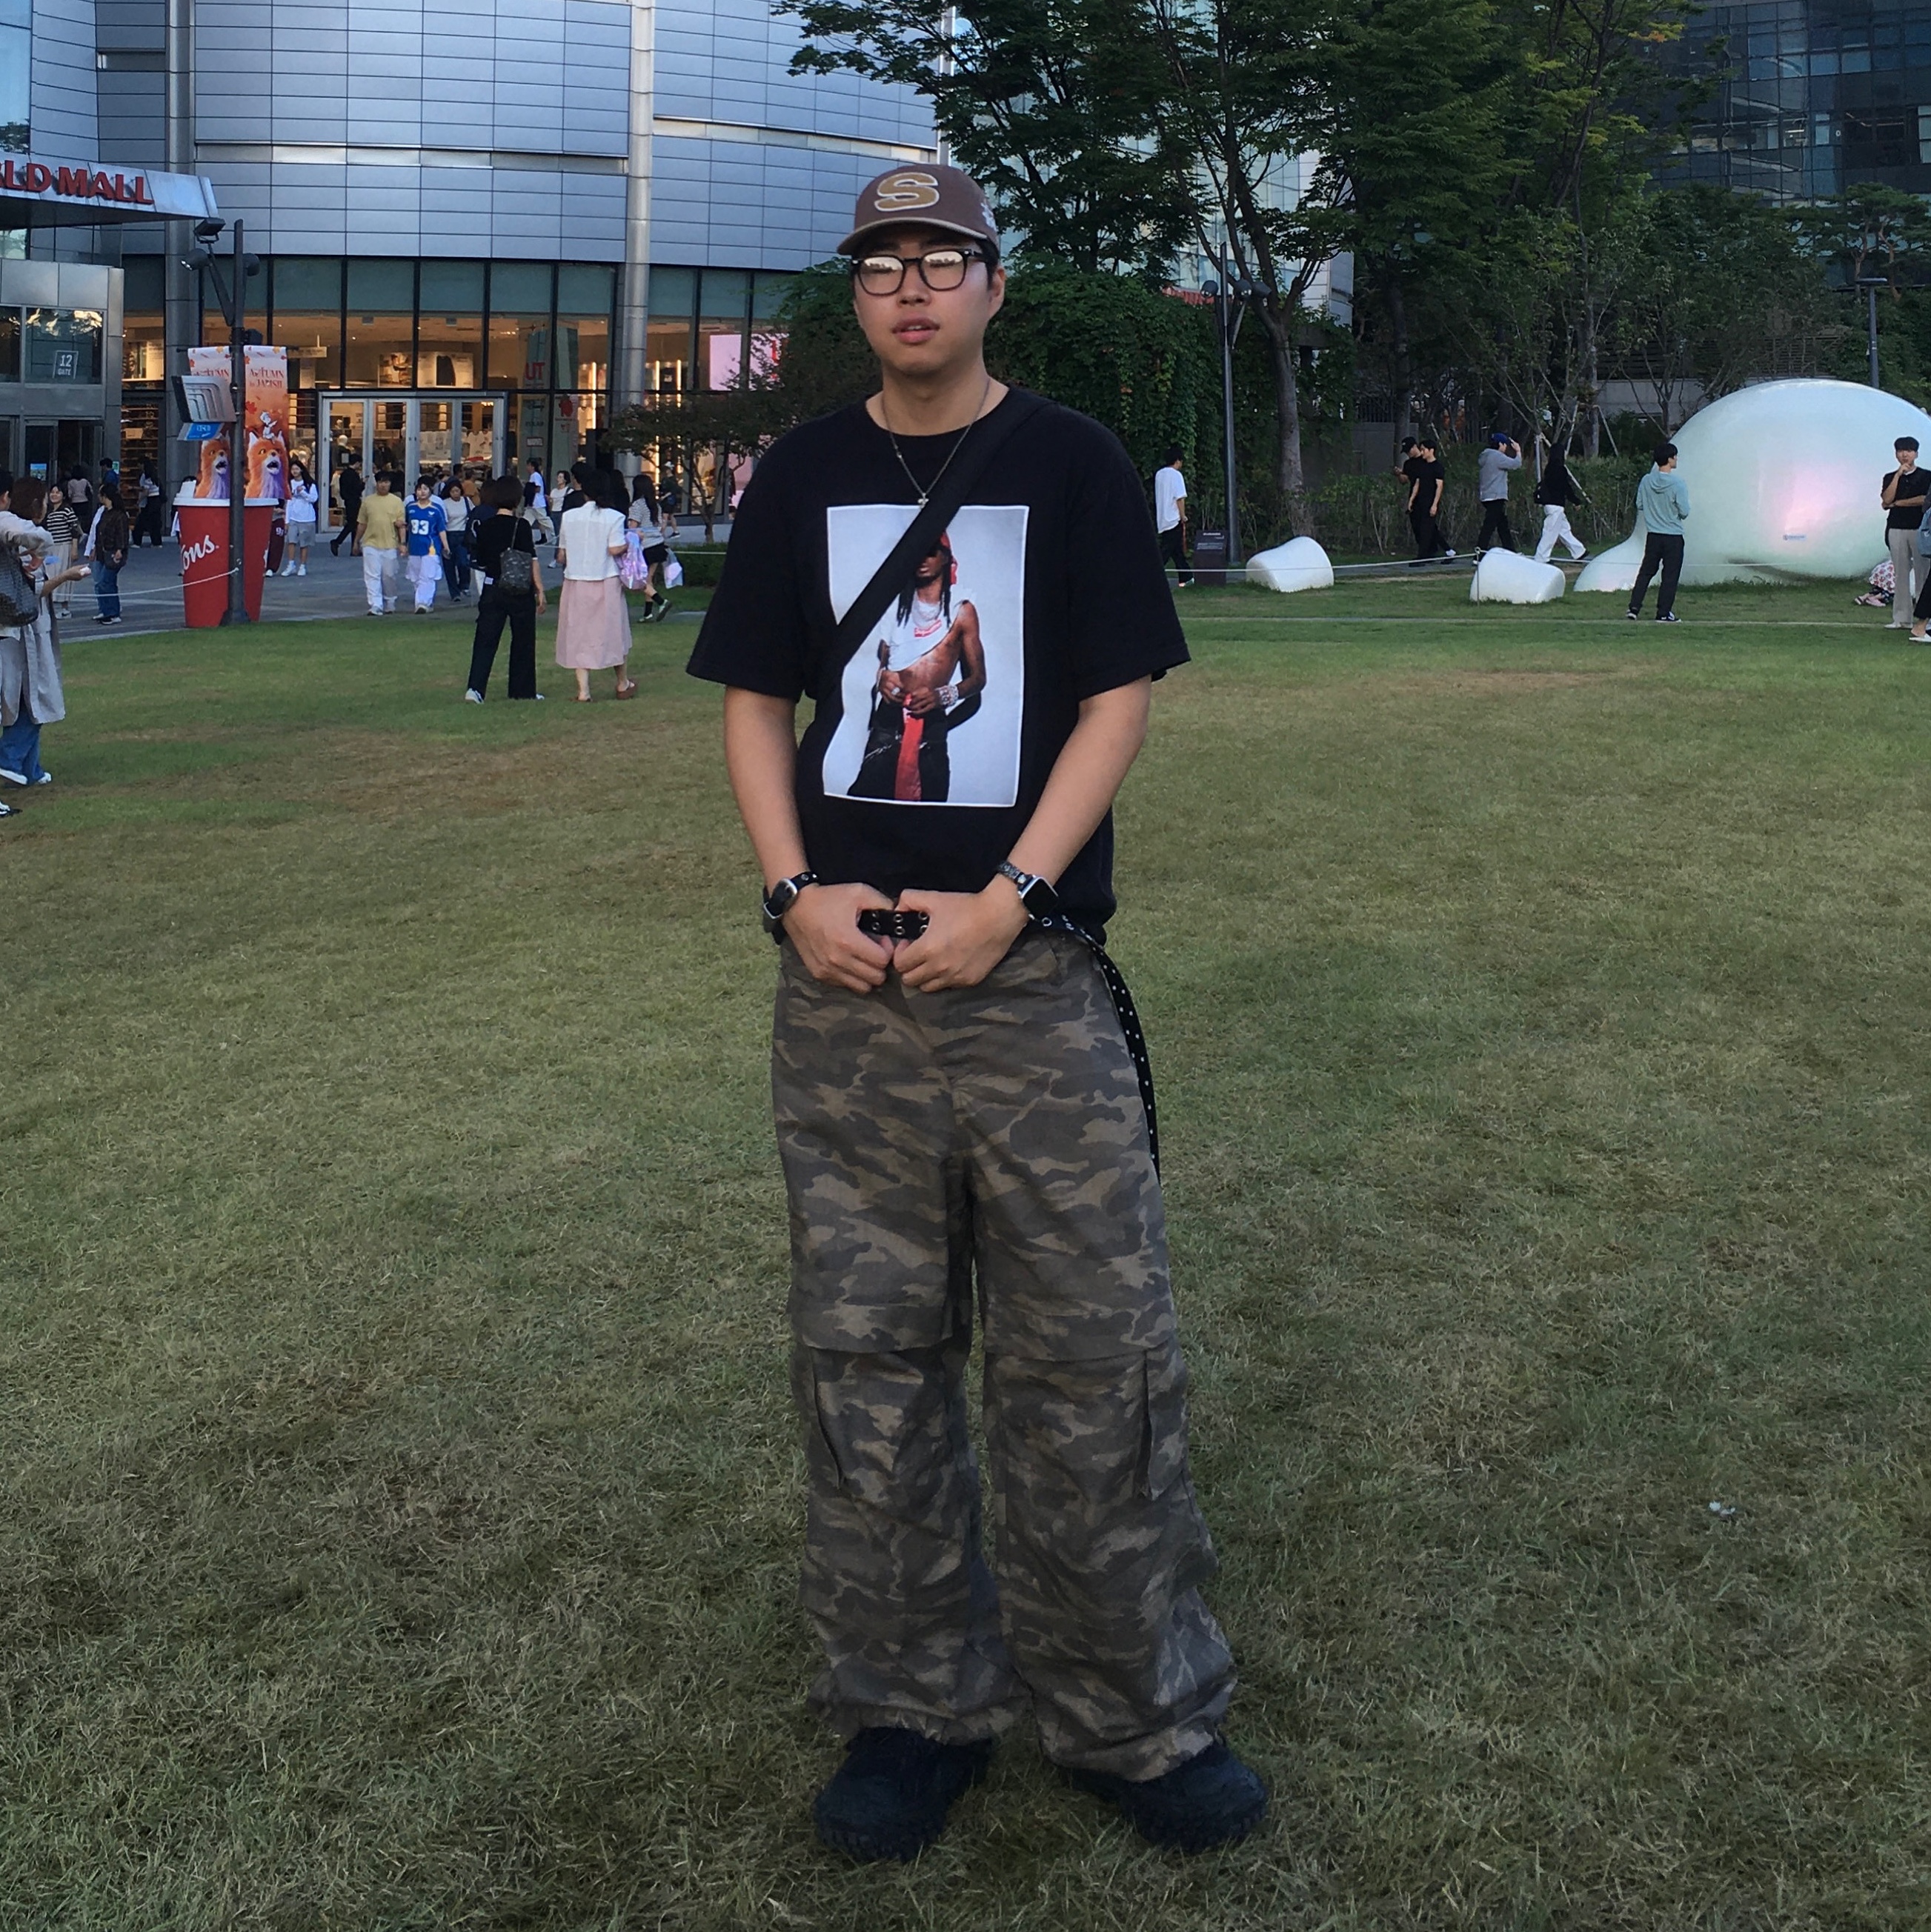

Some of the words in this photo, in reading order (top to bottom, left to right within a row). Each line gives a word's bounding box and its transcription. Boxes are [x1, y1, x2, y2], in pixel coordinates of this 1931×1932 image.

[0, 160, 51, 192] LD
[57, 166, 155, 204] MALL
[874, 172, 940, 212] S
[60, 354, 73, 367] 12
[250, 367, 285, 379] AUTUMN
[525, 362, 545, 379] UT
